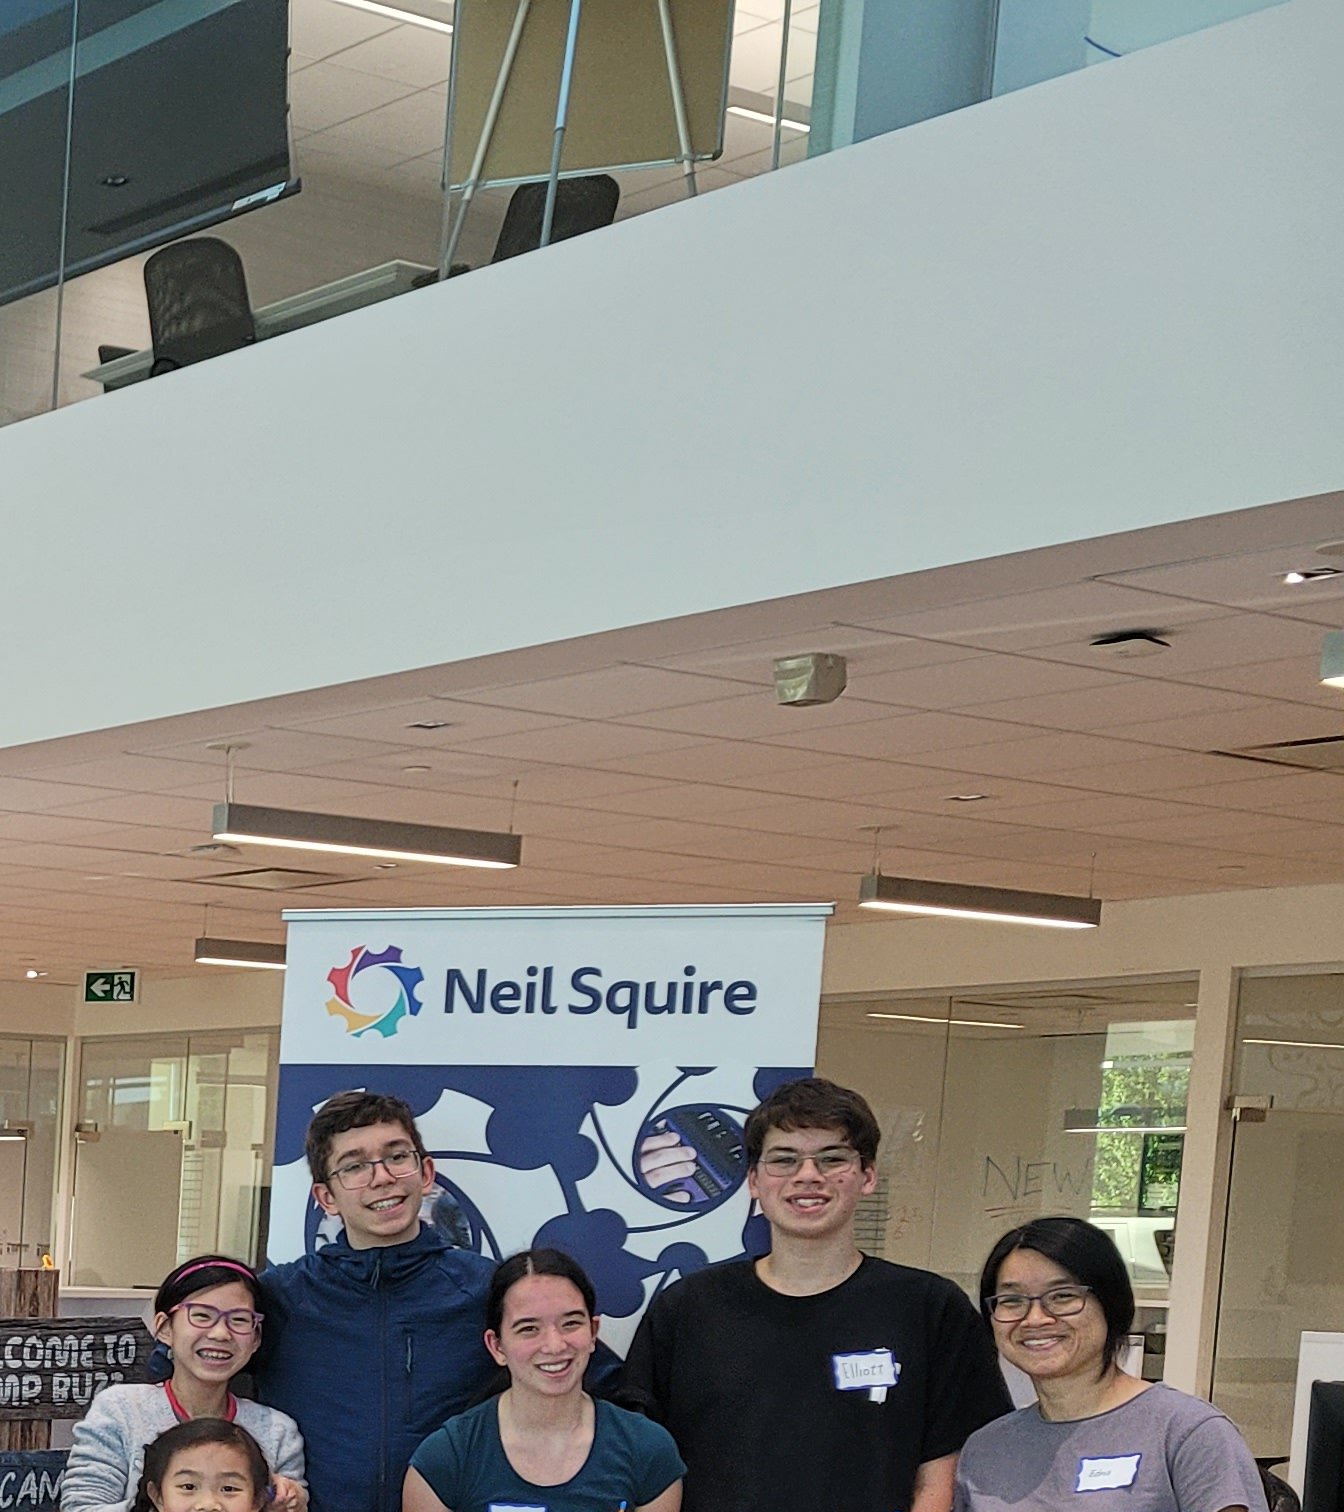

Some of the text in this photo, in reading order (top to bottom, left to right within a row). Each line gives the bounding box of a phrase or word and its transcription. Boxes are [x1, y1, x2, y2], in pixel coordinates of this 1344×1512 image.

[443, 965, 758, 1030] Neil Squire
[983, 1155, 1093, 1200] NEW
[104, 1333, 137, 1367] TO
